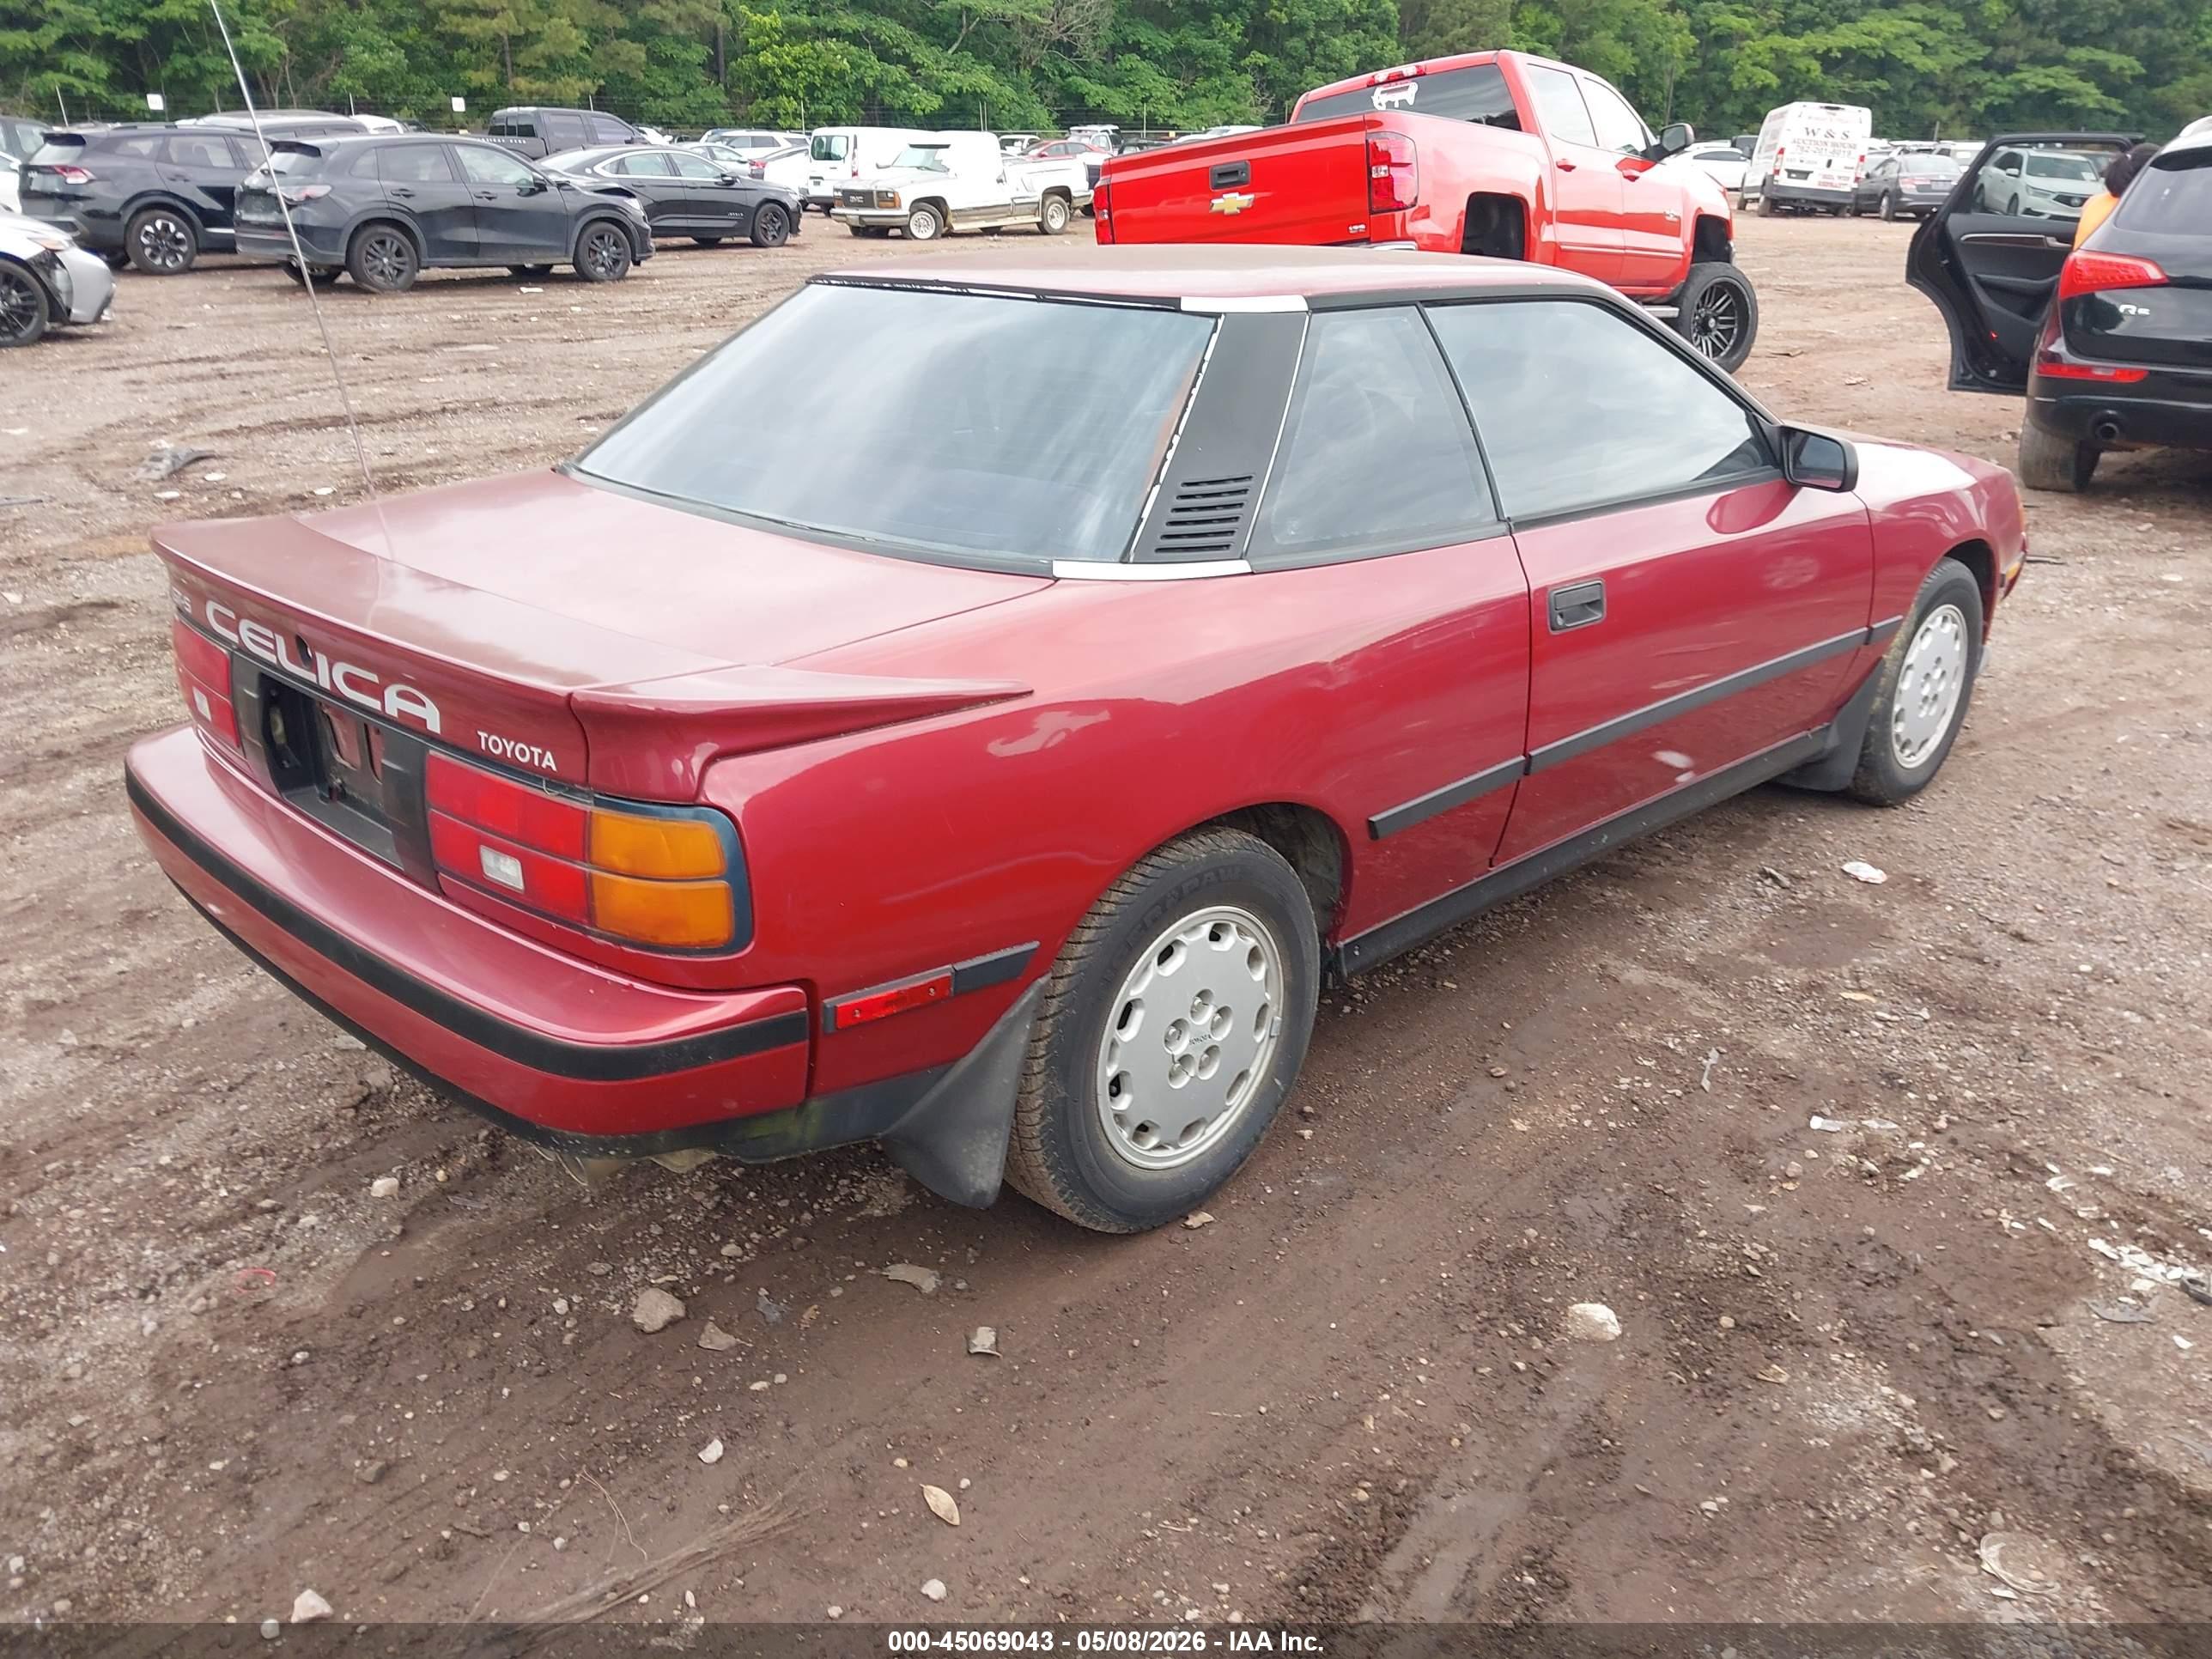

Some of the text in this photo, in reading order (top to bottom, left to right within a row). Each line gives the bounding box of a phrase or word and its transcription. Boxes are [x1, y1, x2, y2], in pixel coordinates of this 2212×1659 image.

[1791, 137, 1828, 147] AUCTION
[1805, 127, 1850, 140] W & S
[205, 600, 441, 734] CELICA
[477, 730, 557, 772] TOYOTA
